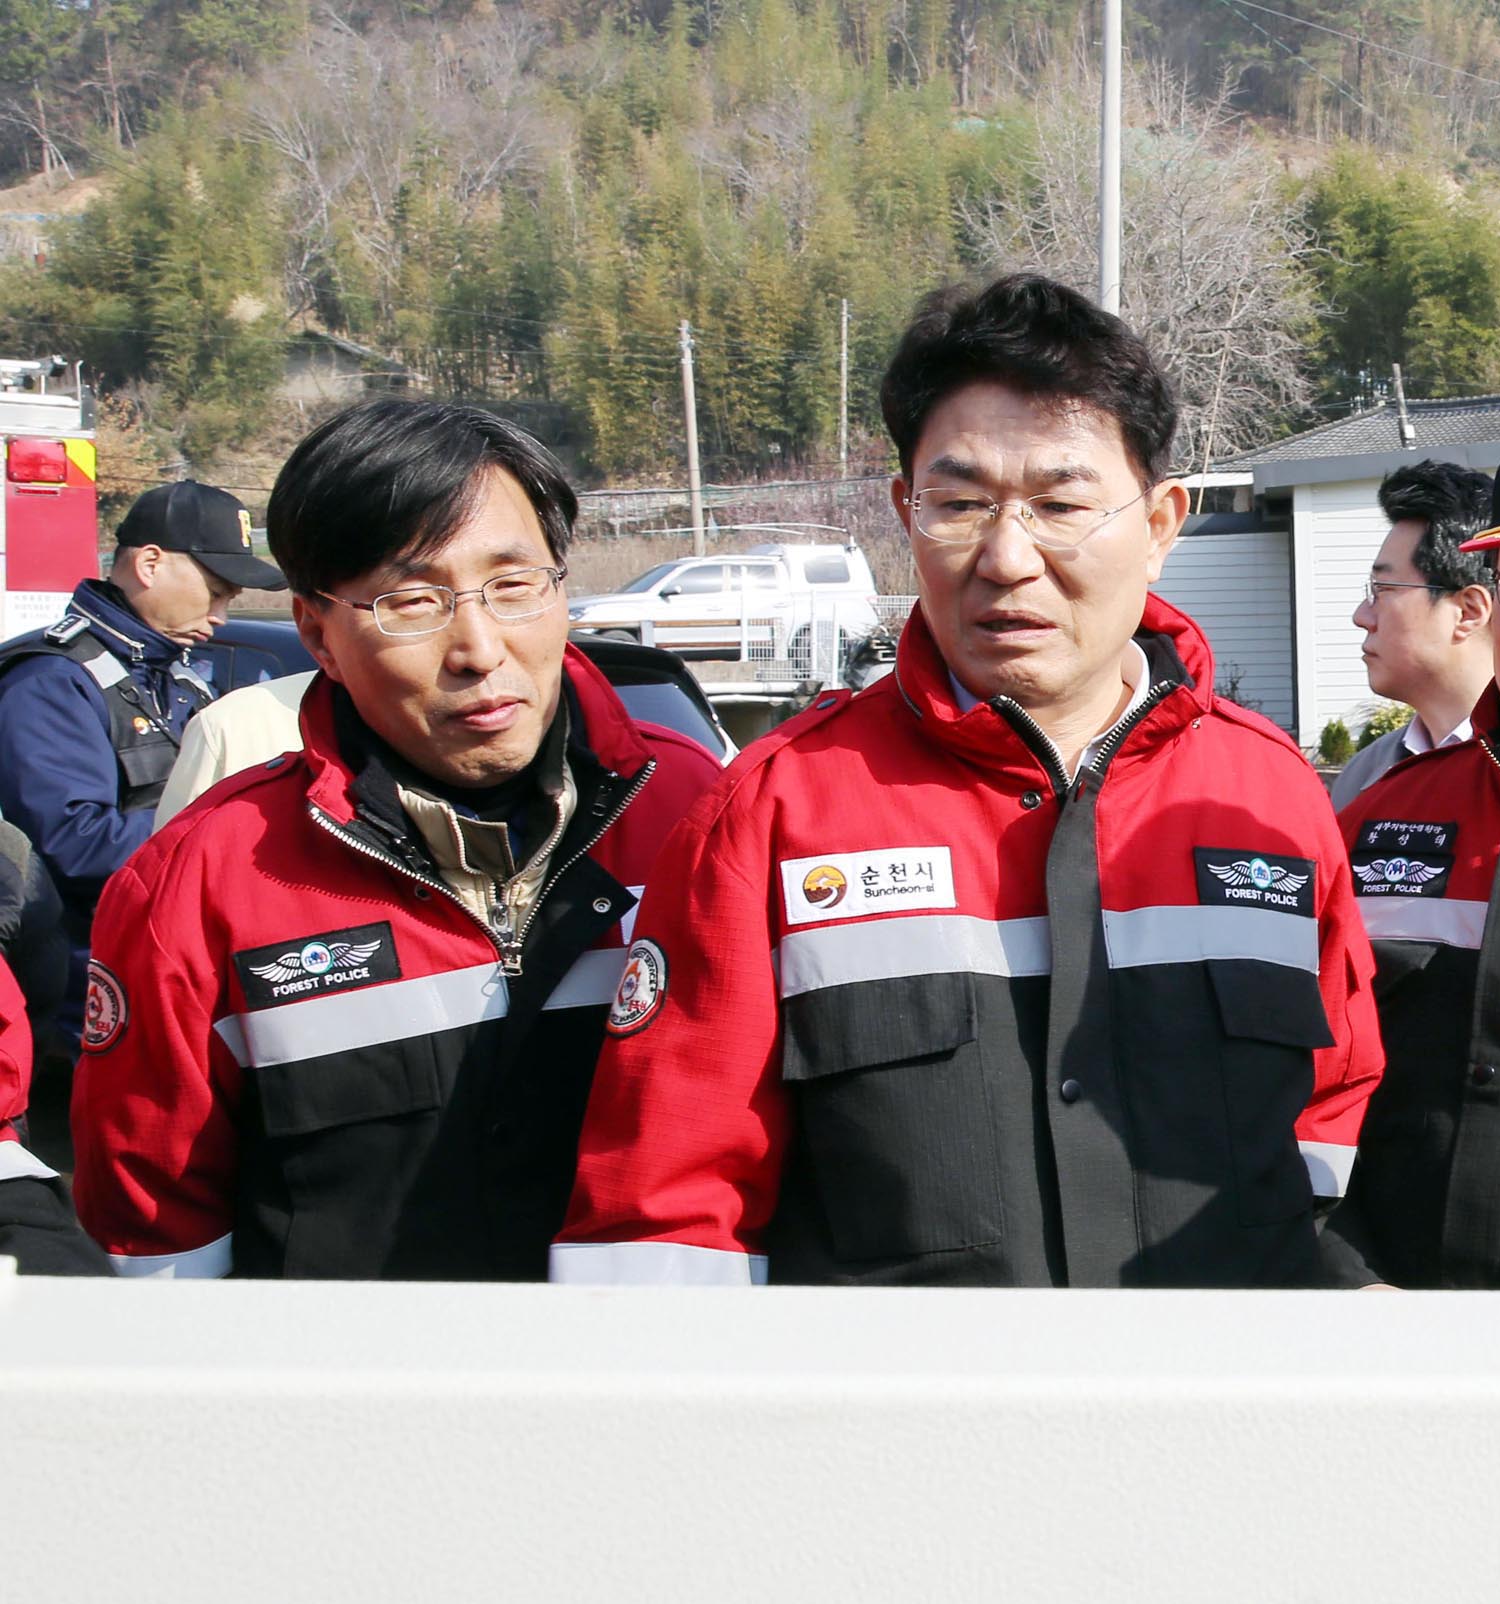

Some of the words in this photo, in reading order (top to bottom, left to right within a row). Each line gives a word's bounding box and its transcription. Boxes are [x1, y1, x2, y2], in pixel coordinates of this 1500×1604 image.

[860, 862, 934, 886] 순천시
[864, 883, 934, 898] Suncheon-si
[1225, 888, 1262, 900] FOREST
[1265, 892, 1298, 907] POLICE
[1362, 884, 1391, 893] FOREST
[1394, 884, 1424, 893] POLICE
[272, 976, 320, 997] FOREST
[324, 967, 370, 986] POLICE
